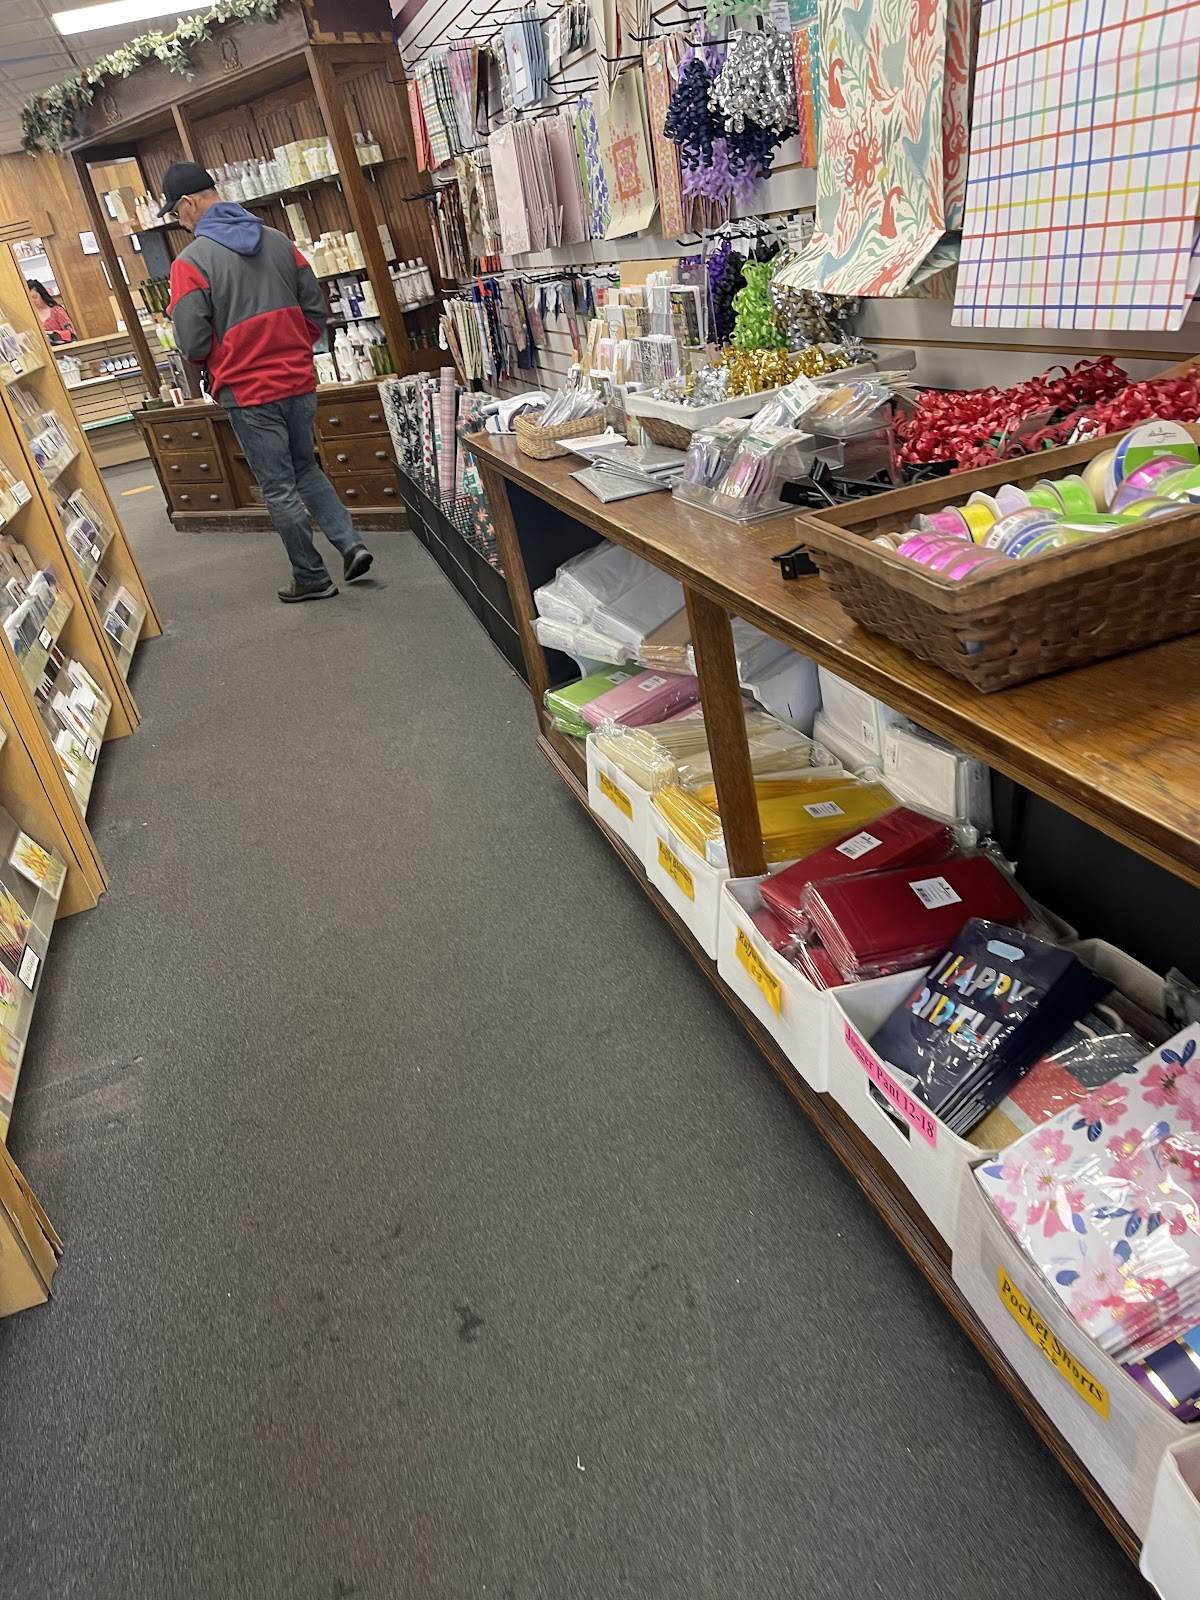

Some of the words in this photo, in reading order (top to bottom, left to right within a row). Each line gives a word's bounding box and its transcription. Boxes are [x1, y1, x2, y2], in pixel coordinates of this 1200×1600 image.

[845, 1027, 874, 1070] Jogger
[877, 1066, 900, 1102] Pant
[904, 1097, 934, 1138] 12-18
[1002, 1279, 1049, 1340] Pocket
[1052, 1336, 1104, 1402] Shorts
